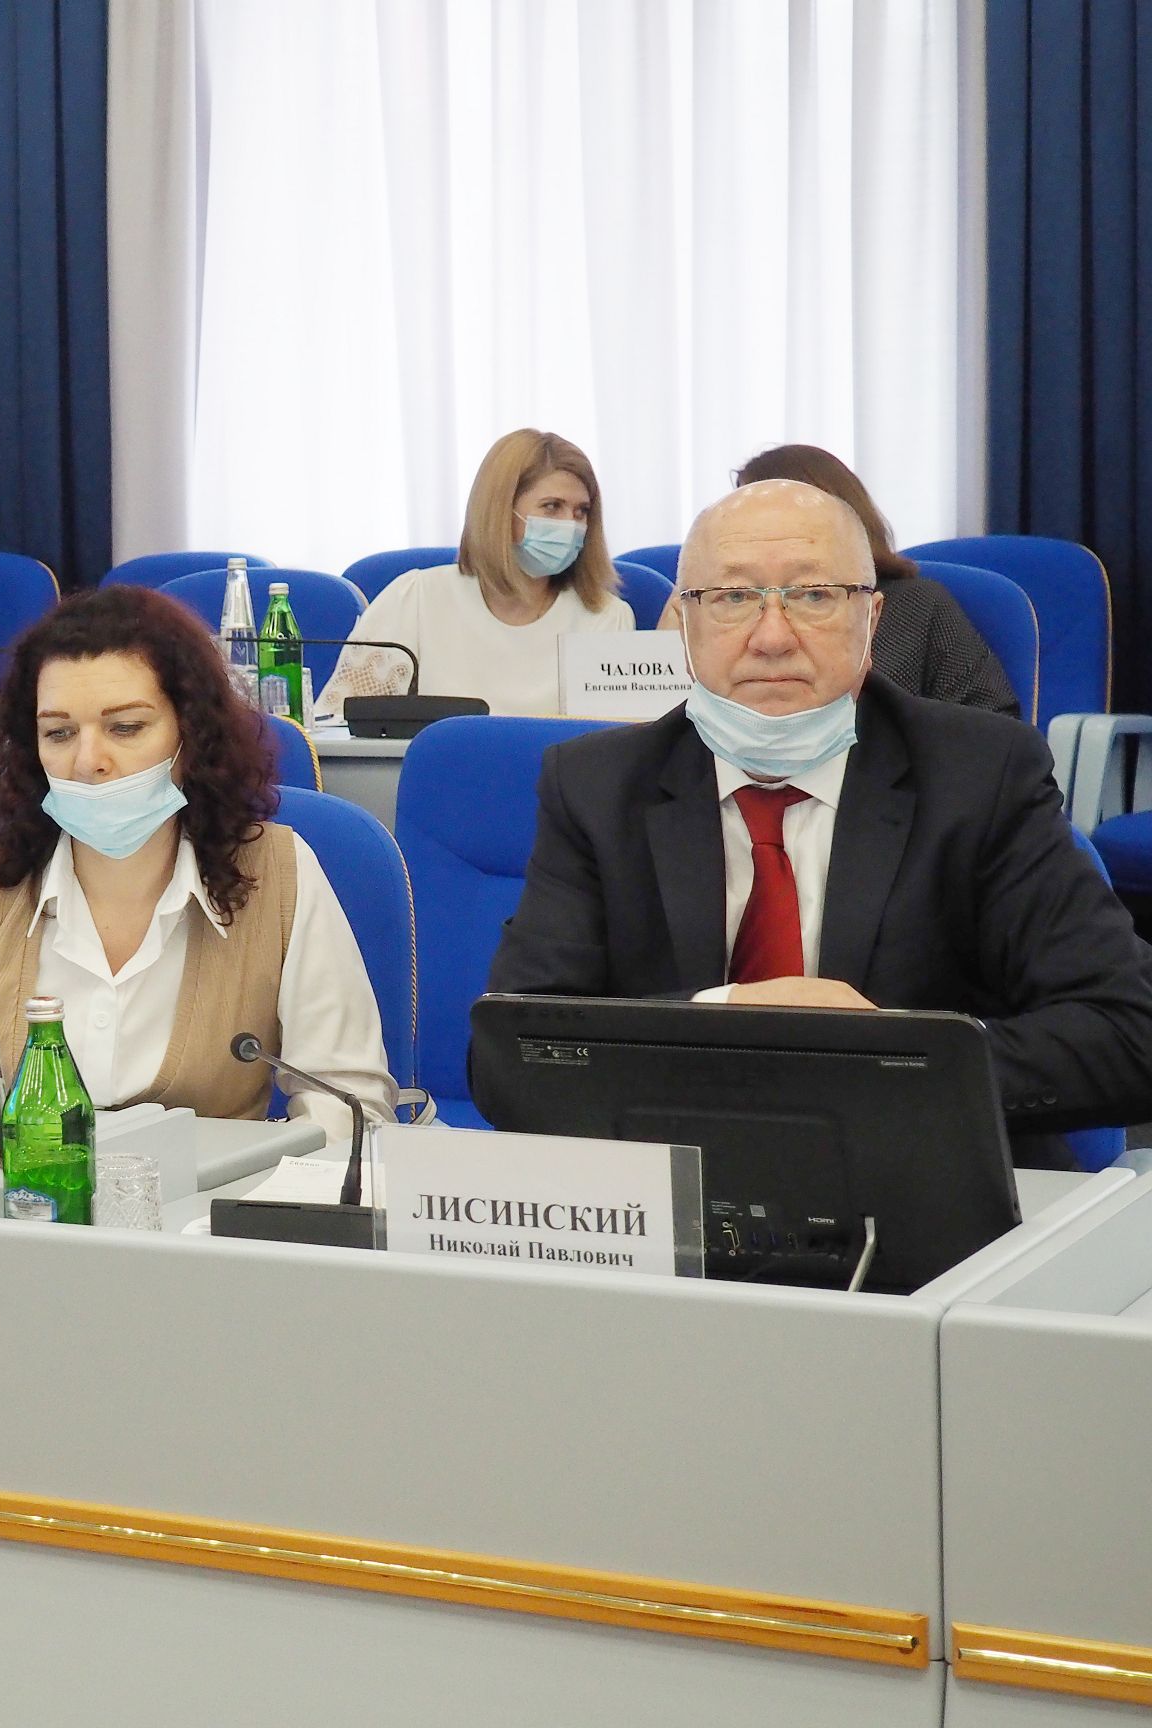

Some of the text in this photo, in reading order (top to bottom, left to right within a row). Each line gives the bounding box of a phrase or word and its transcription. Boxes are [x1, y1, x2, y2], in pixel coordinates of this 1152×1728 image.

[600, 662, 675, 677] ЧАЛОВА
[584, 682, 628, 692] Евгения
[411, 1193, 648, 1237] ЛИСИНСКИЙ
[428, 1233, 634, 1267] Николай Павлович
